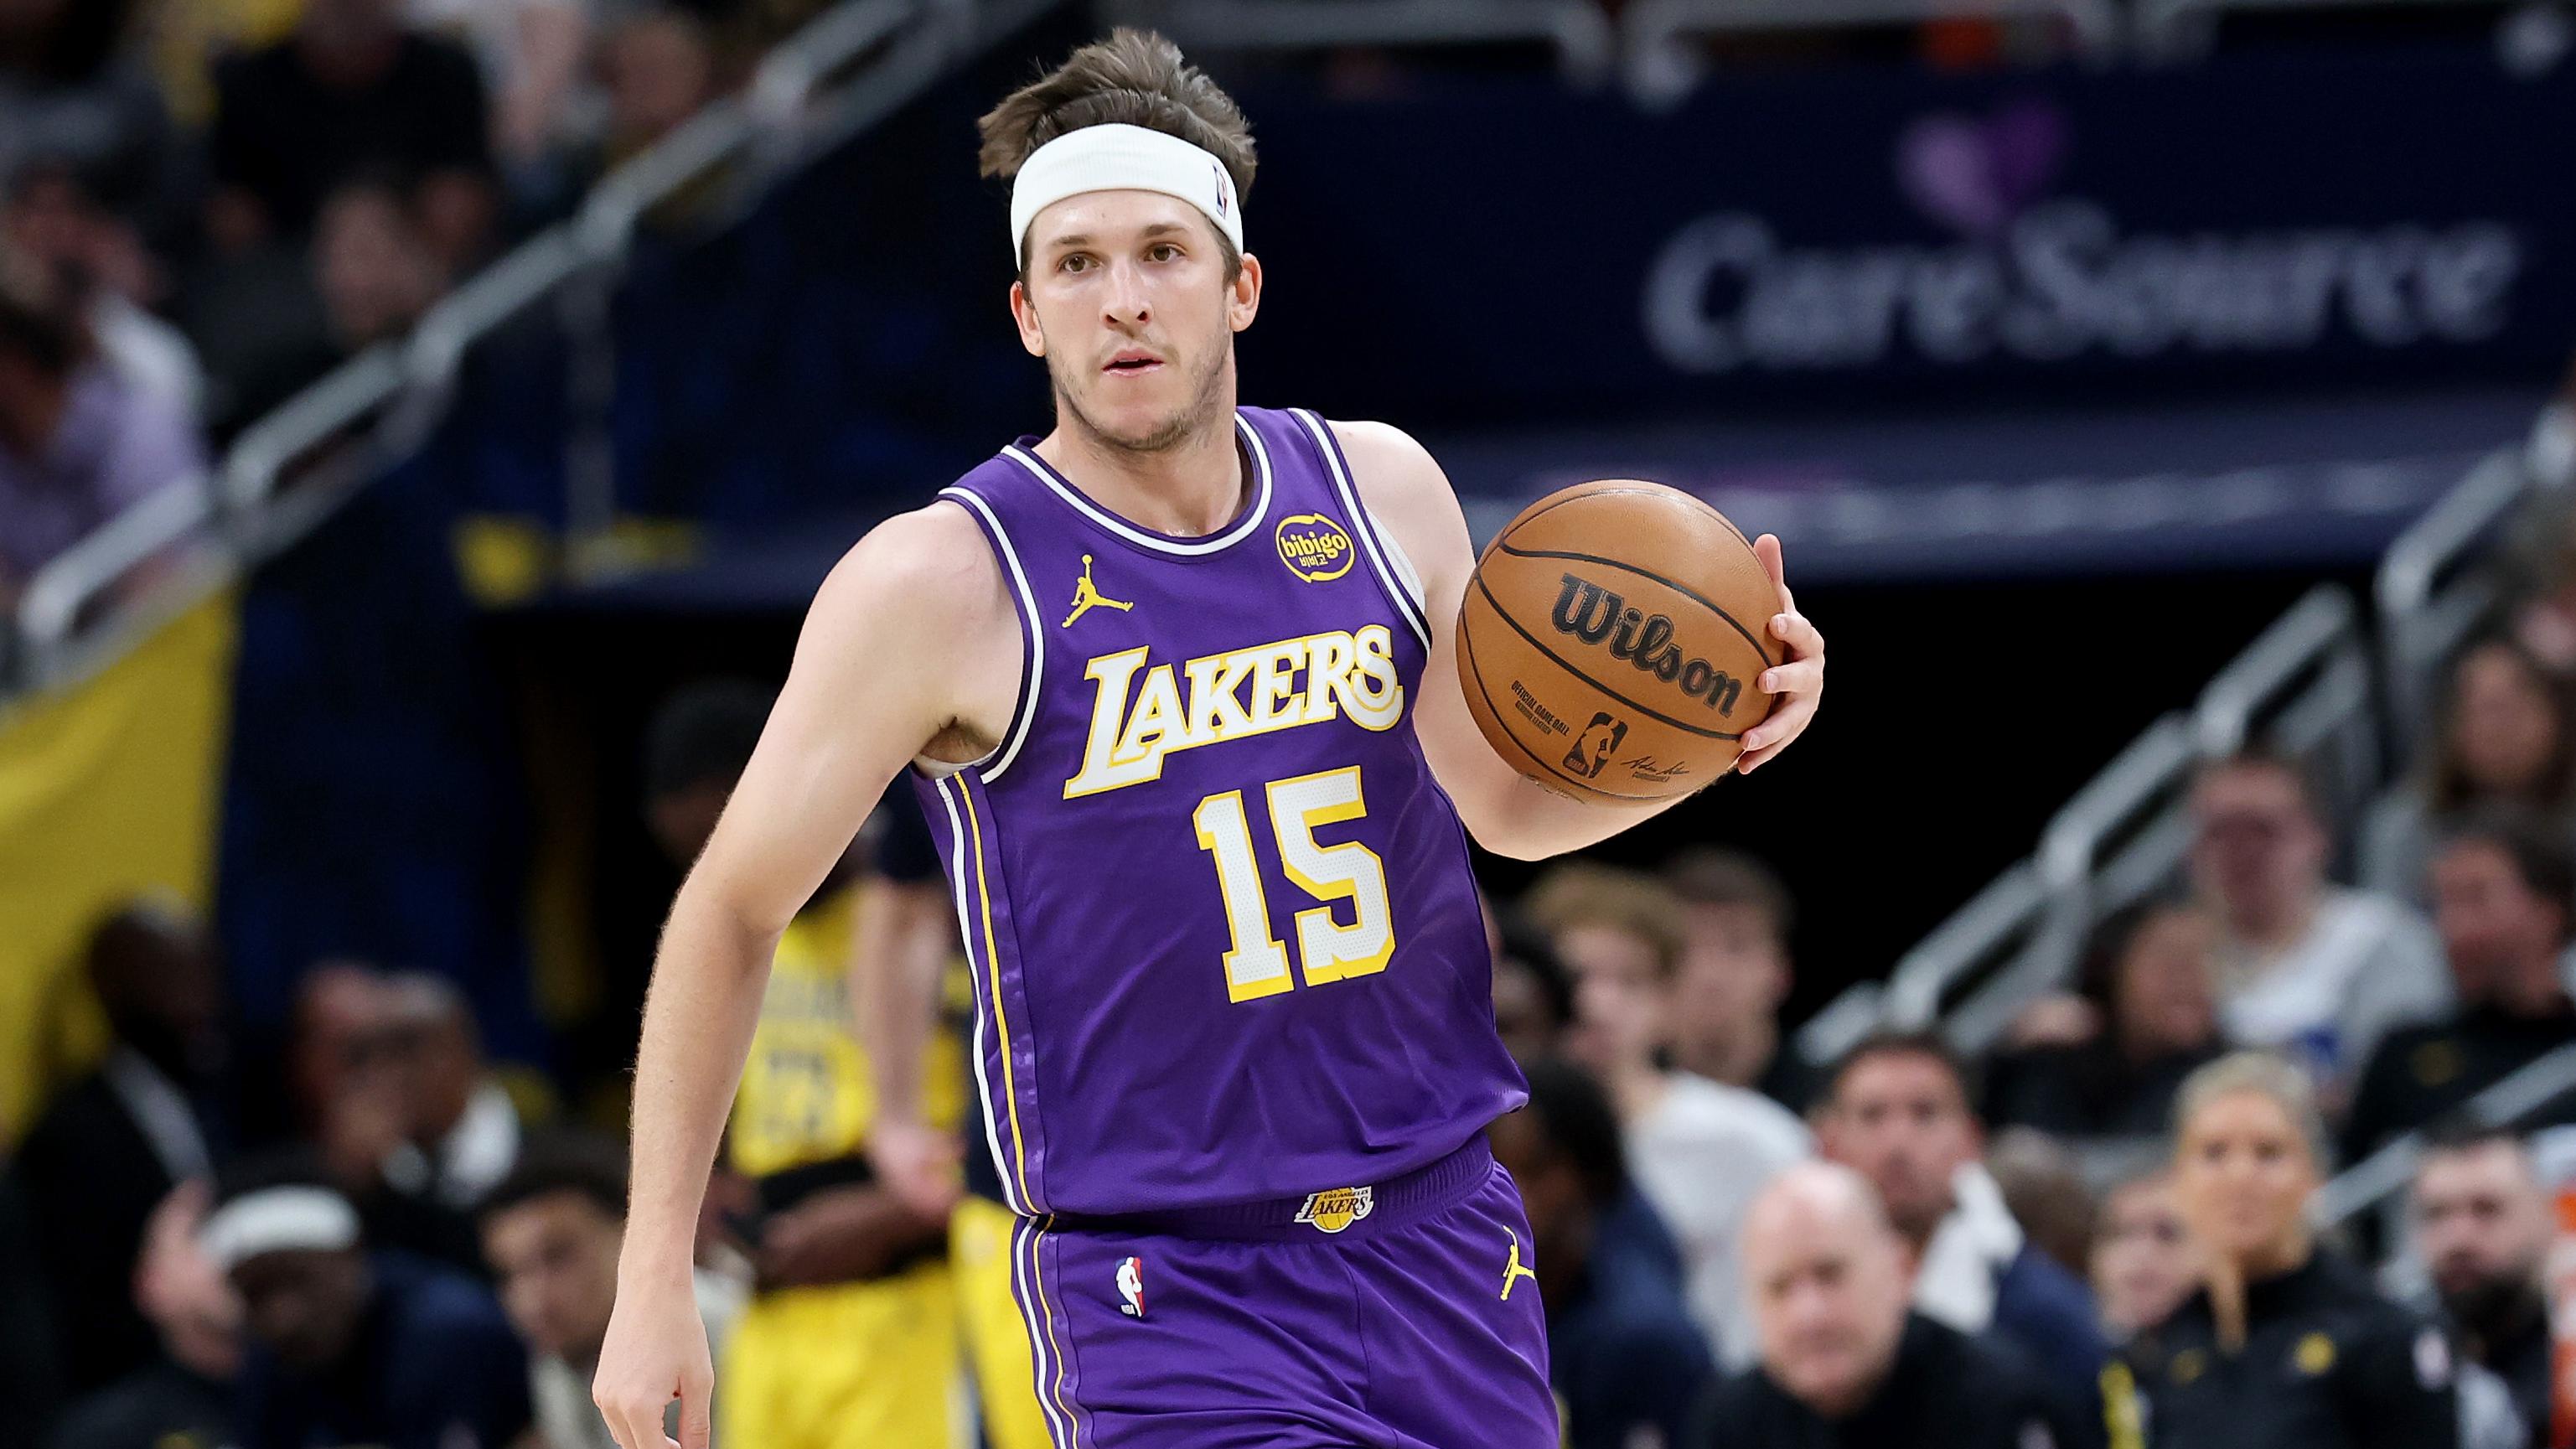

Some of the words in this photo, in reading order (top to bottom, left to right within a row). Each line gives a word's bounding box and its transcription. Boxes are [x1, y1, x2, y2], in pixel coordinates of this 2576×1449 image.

[1280, 530, 1347, 559] bibigo
[1298, 553, 1328, 567] 비비고
[1552, 572, 1742, 718] Wilson
[1063, 624, 1404, 800] LAKERS
[1511, 680, 1538, 710] OFFICIAL
[1534, 704, 1555, 725] GAME
[1552, 718, 1570, 737] BALL
[1192, 764, 1396, 1003] 15
[1301, 1195, 1371, 1219] LAKERS
